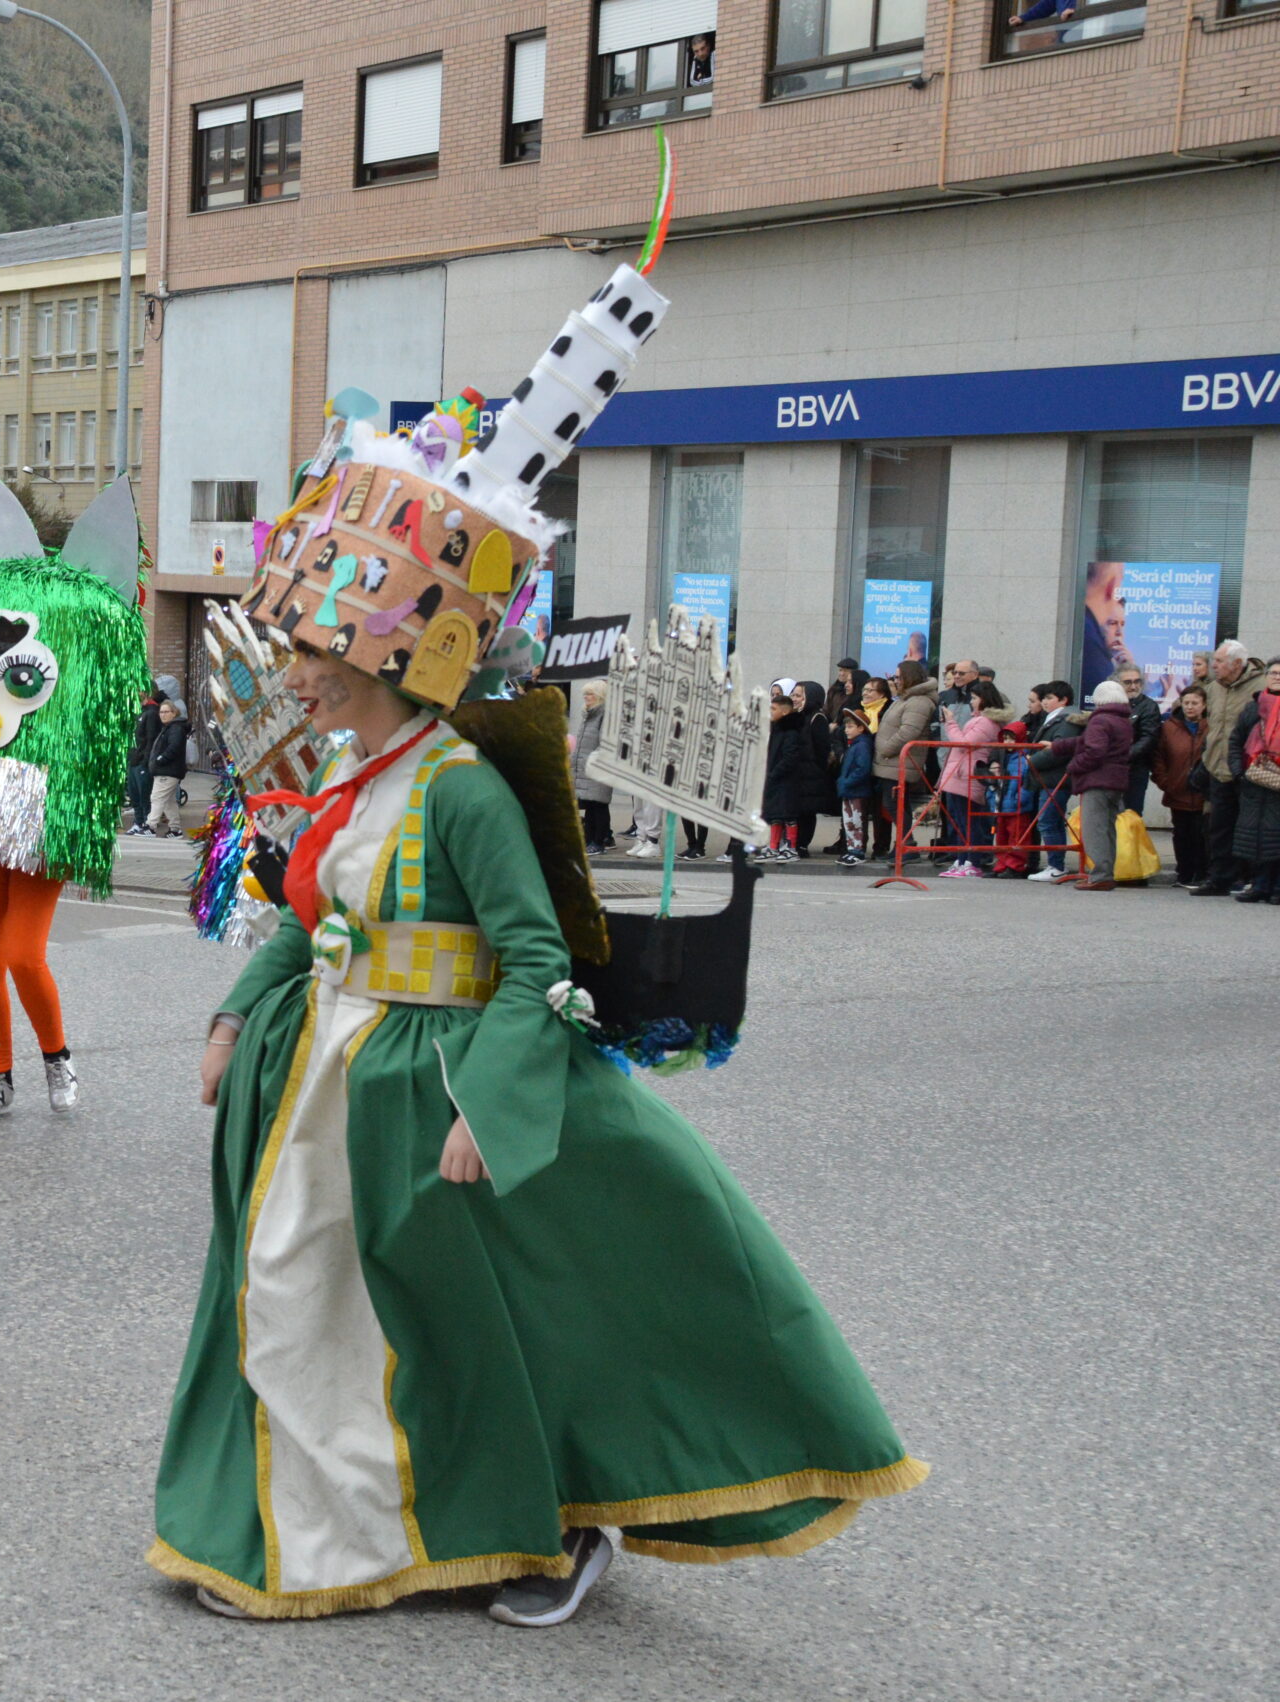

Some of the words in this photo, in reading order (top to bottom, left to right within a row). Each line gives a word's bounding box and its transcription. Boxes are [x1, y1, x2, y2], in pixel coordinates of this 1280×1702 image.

[777, 389, 860, 428] BBVA
[397, 420, 417, 431] BB
[1161, 569, 1173, 583] el
[1175, 570, 1214, 585] mejor
[1113, 587, 1153, 600] grupo
[1155, 584, 1171, 598] de
[1125, 599, 1212, 615] profesionales
[1148, 615, 1169, 629] del
[1171, 617, 1210, 630] sector
[545, 624, 623, 668] MILAN
[1178, 631, 1194, 645] de
[1196, 632, 1209, 646] la
[1168, 646, 1193, 660] ban
